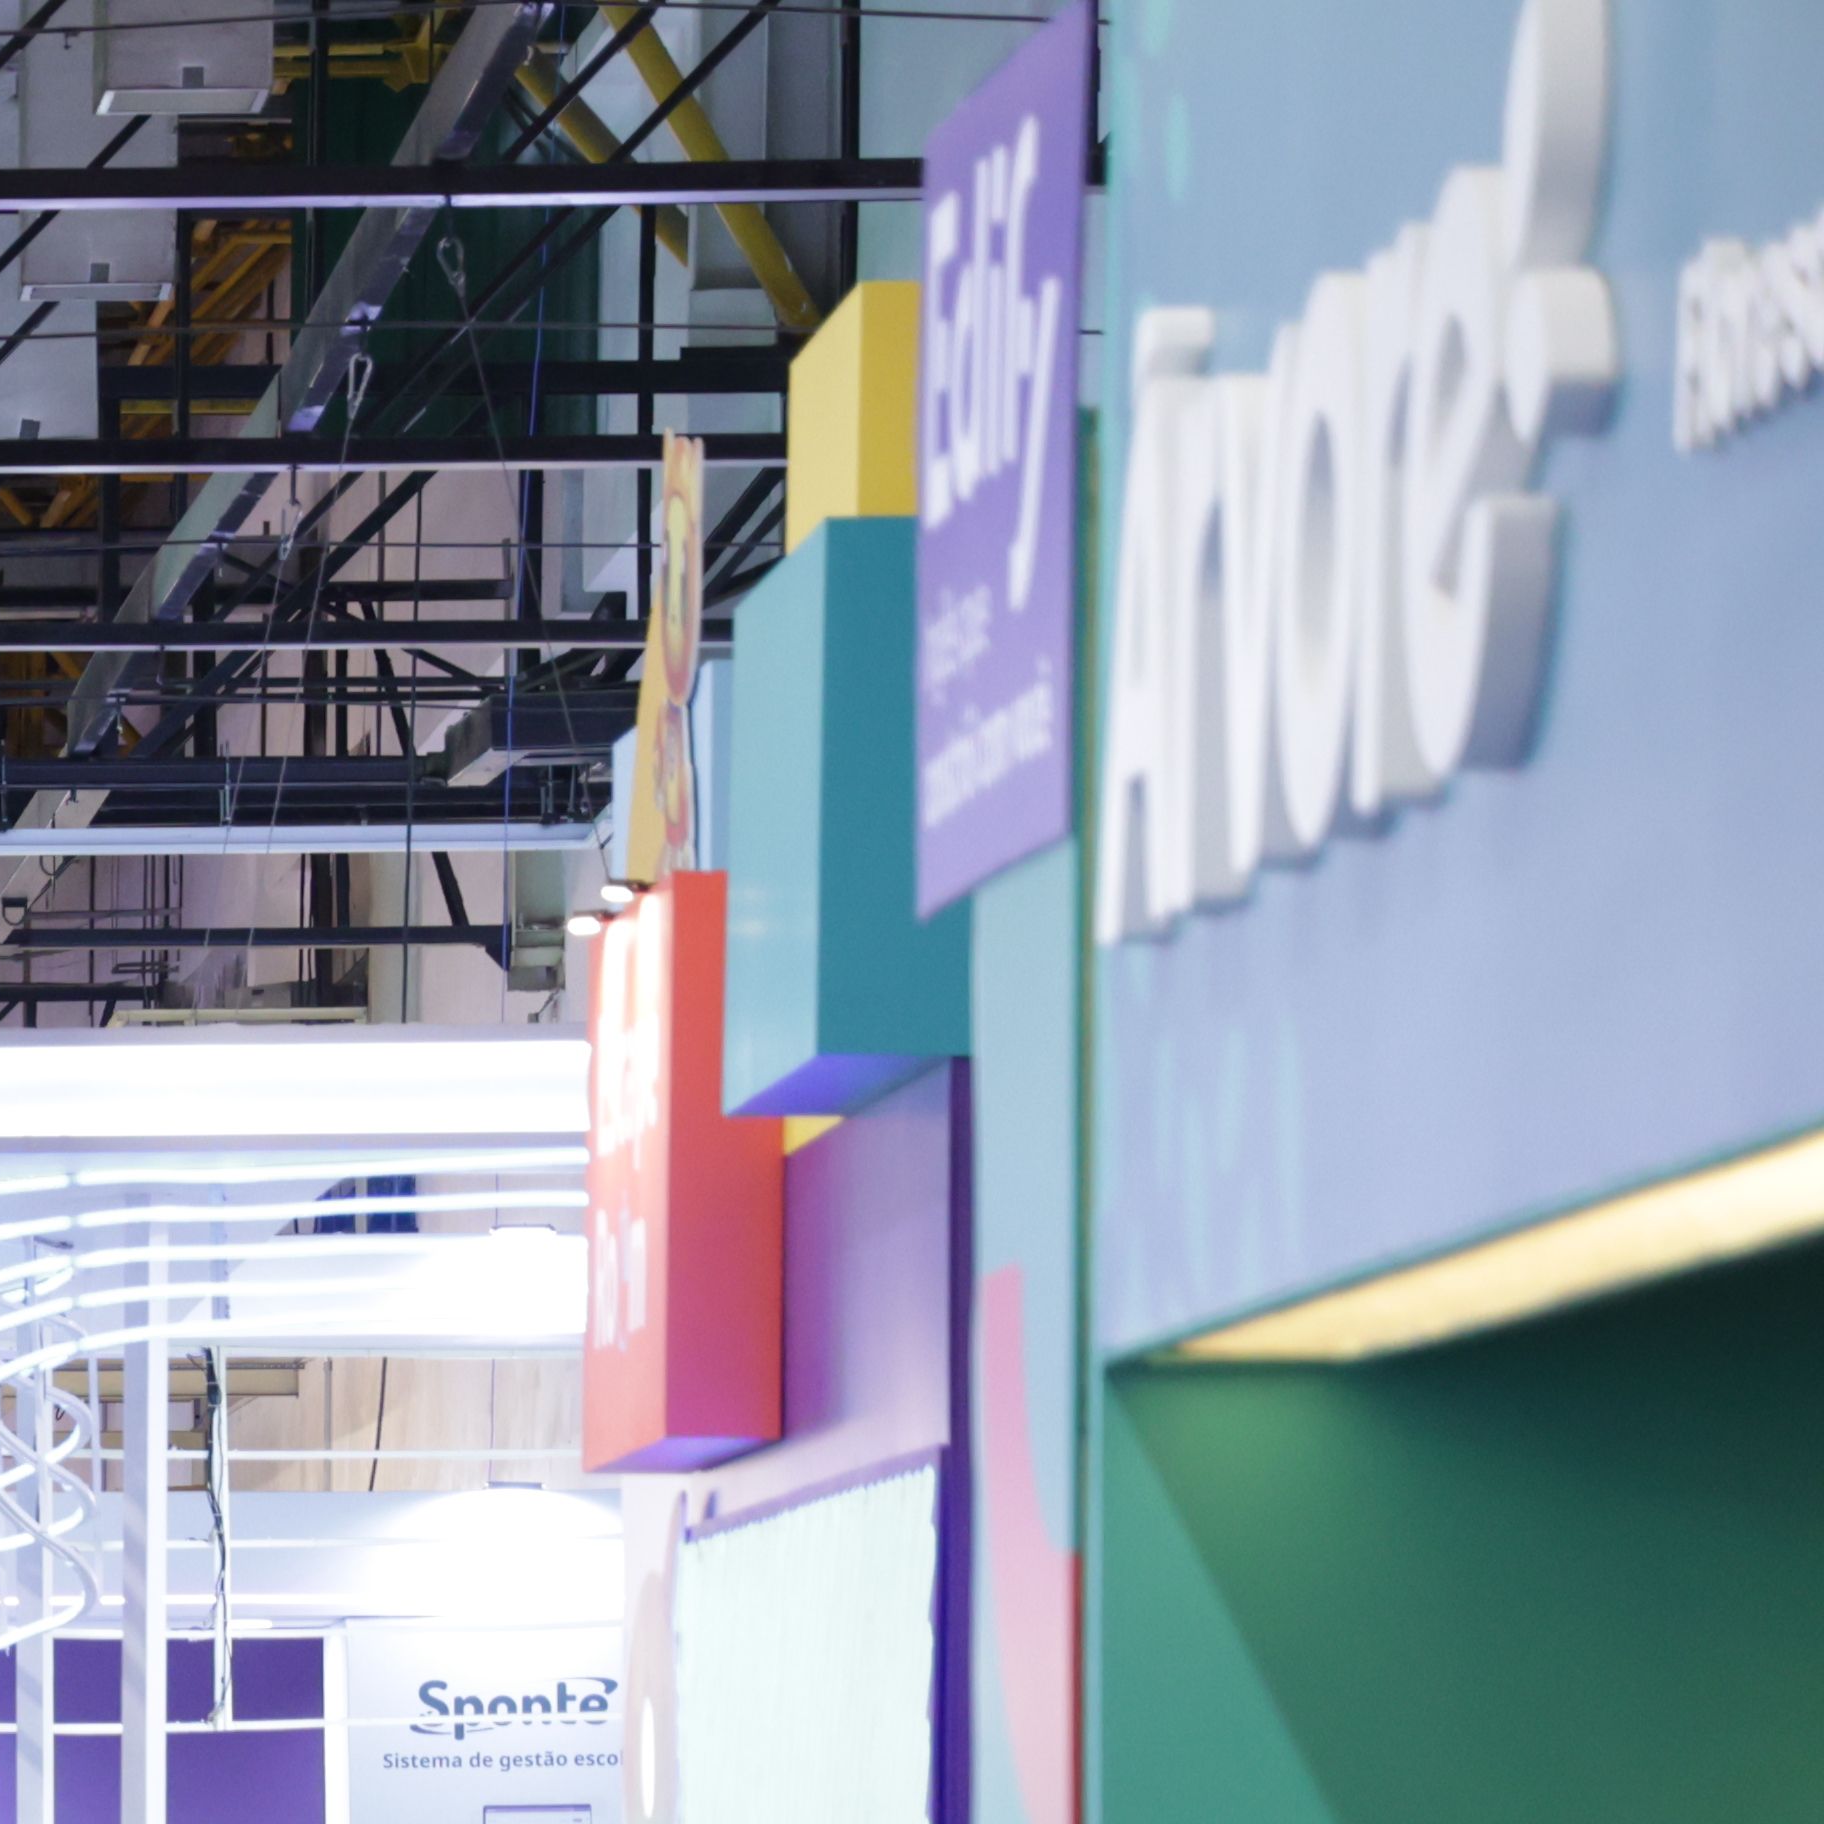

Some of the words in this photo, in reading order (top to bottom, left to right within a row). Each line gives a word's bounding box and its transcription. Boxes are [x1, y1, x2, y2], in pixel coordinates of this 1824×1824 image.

[410, 1677, 618, 1740] Sponte
[382, 1751, 463, 1769] Sistema
[469, 1751, 494, 1769] de
[499, 1750, 568, 1772] gestão
